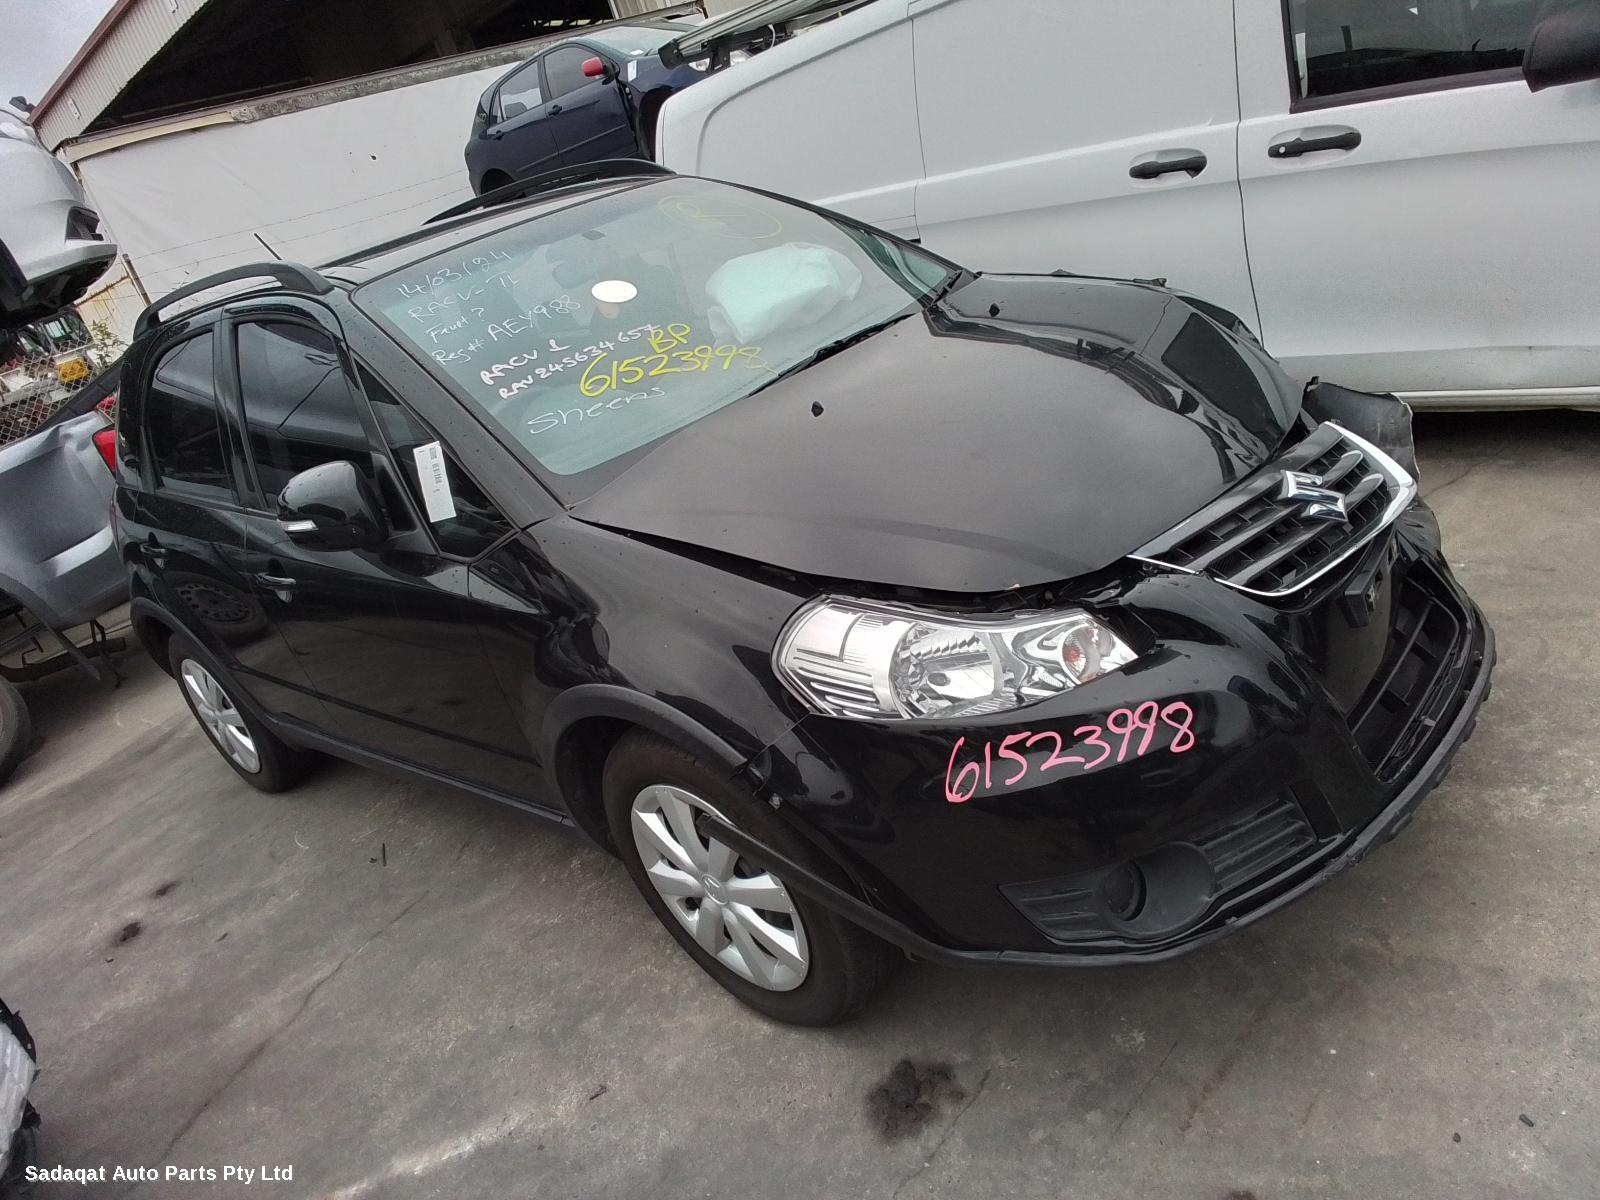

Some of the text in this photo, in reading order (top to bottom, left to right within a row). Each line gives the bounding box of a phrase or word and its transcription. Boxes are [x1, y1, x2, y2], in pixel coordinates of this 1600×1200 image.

[648, 323, 691, 354] BP
[480, 349, 538, 385] RACV
[580, 345, 768, 397] 61523998
[945, 701, 1195, 803] 61523998
